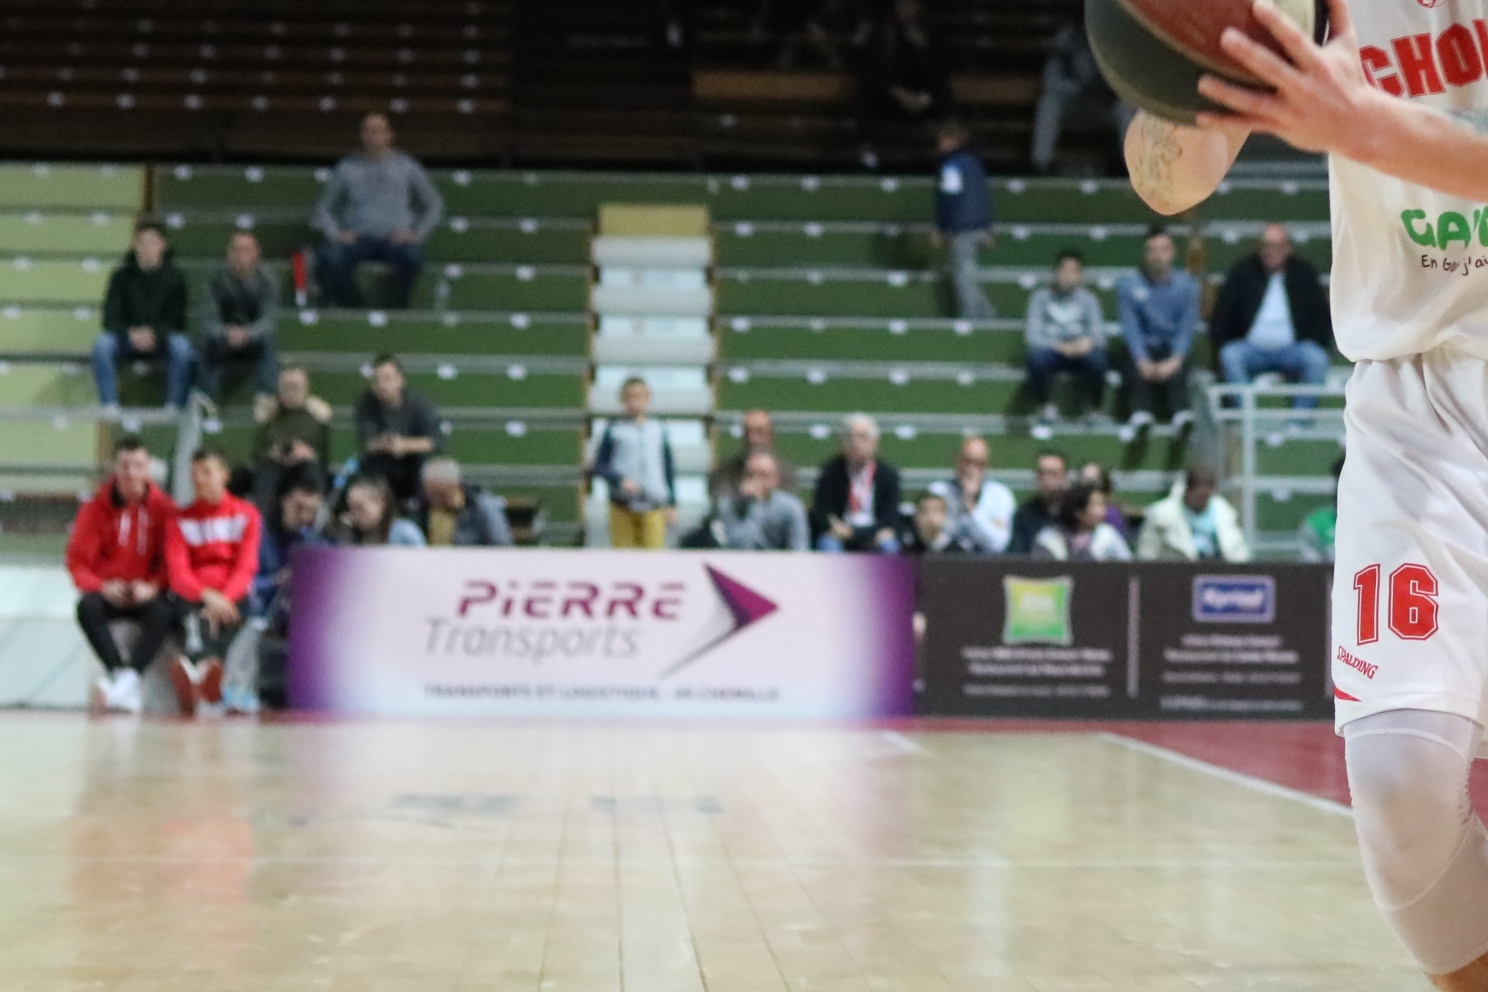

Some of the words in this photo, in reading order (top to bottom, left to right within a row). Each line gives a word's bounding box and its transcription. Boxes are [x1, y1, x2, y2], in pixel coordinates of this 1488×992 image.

[1421, 255, 1438, 269] En
[1353, 562, 1439, 646] 16
[425, 617, 641, 663] Transports
[1336, 645, 1379, 680] SPALDING
